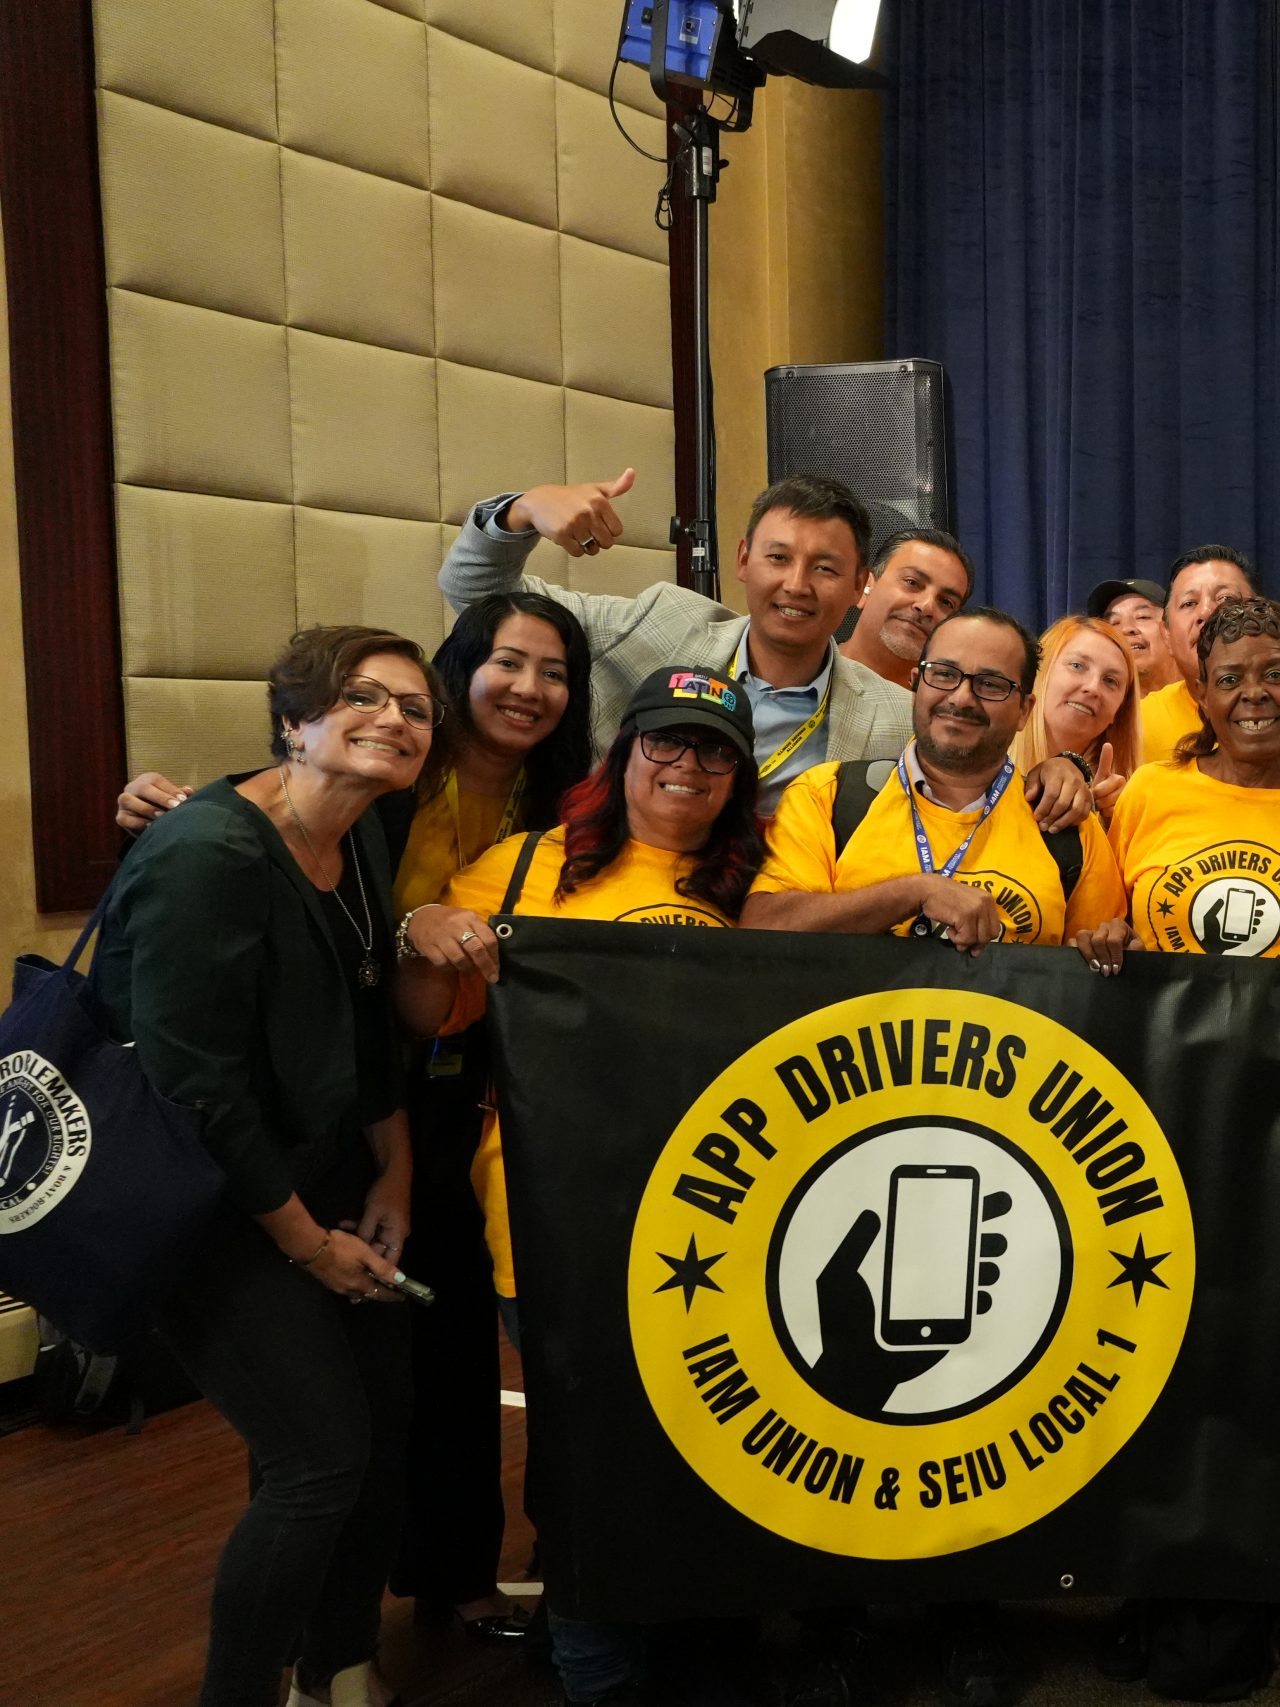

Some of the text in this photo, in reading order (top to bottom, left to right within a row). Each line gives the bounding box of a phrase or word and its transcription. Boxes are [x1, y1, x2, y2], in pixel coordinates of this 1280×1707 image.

[990, 789, 1000, 805] IAM
[920, 846, 931, 863] IAM
[1163, 866, 1194, 898] APP
[1197, 850, 1272, 876] DRIVERS
[996, 886, 1033, 934] UNION
[1164, 925, 1185, 951] IAM
[32, 1089, 50, 1108] FOR
[46, 1110, 61, 1132] OUR
[672, 1018, 1165, 1227] APP DRIVERS UNION
[682, 1327, 1138, 1511] IAM UNION & SEIU LOCAL 1
